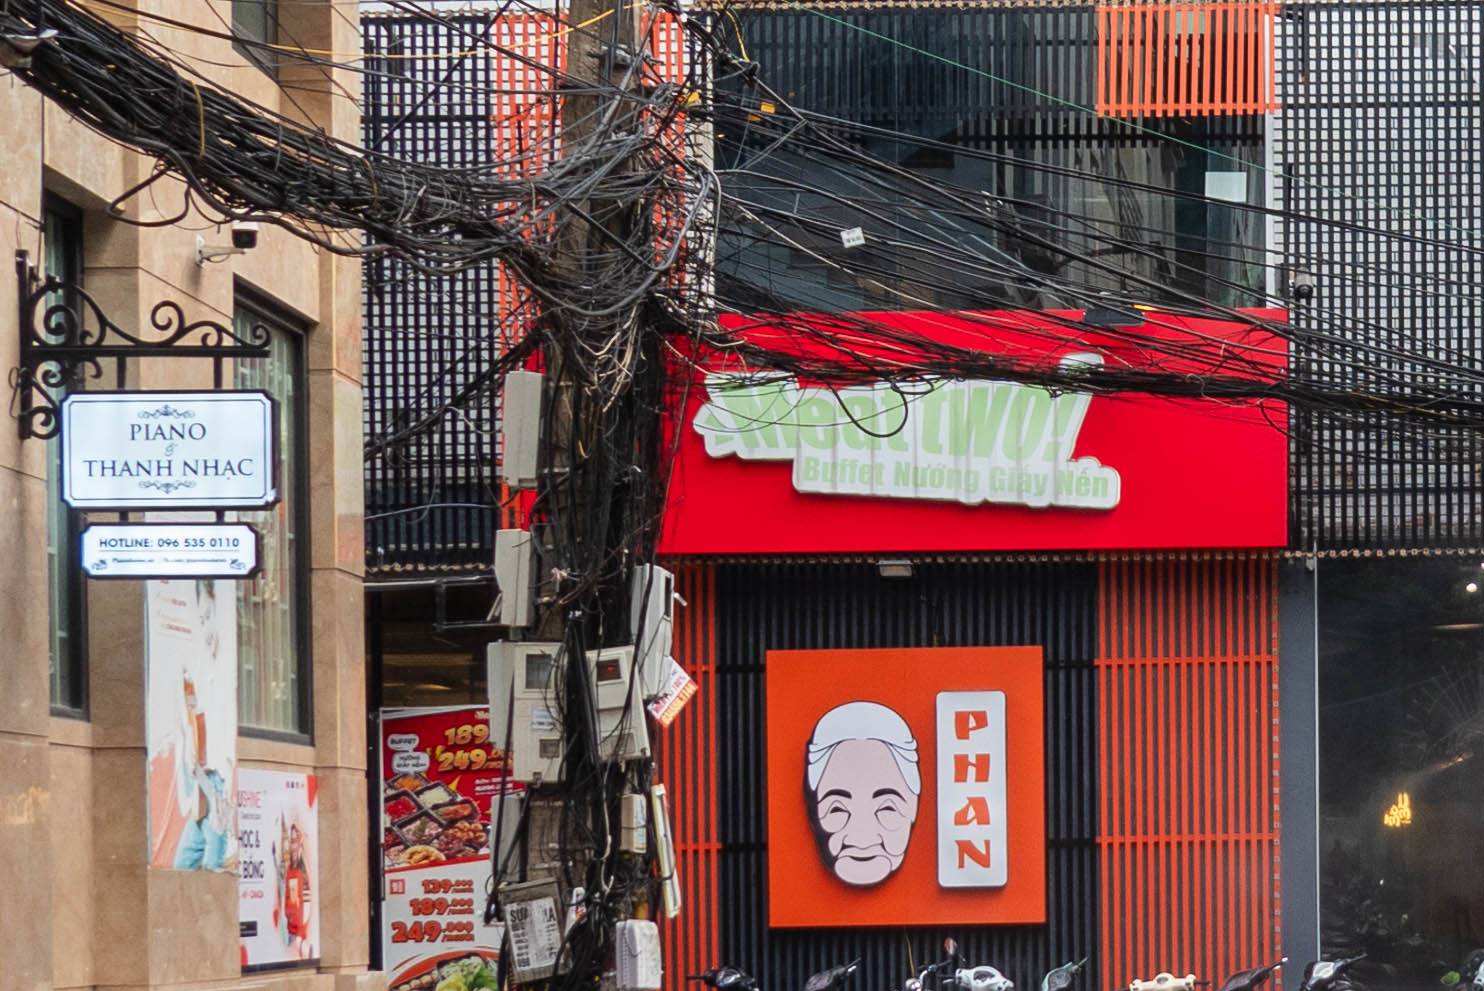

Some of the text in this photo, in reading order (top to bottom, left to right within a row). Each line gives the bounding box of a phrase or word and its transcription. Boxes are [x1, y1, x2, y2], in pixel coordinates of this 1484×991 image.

[129, 422, 207, 441] PIANO
[83, 458, 254, 481] THANH NHẠC
[801, 458, 885, 486] Buffet
[99, 538, 240, 548] HOTLINE: 096 535 0110
[953, 710, 991, 869] PHAN
